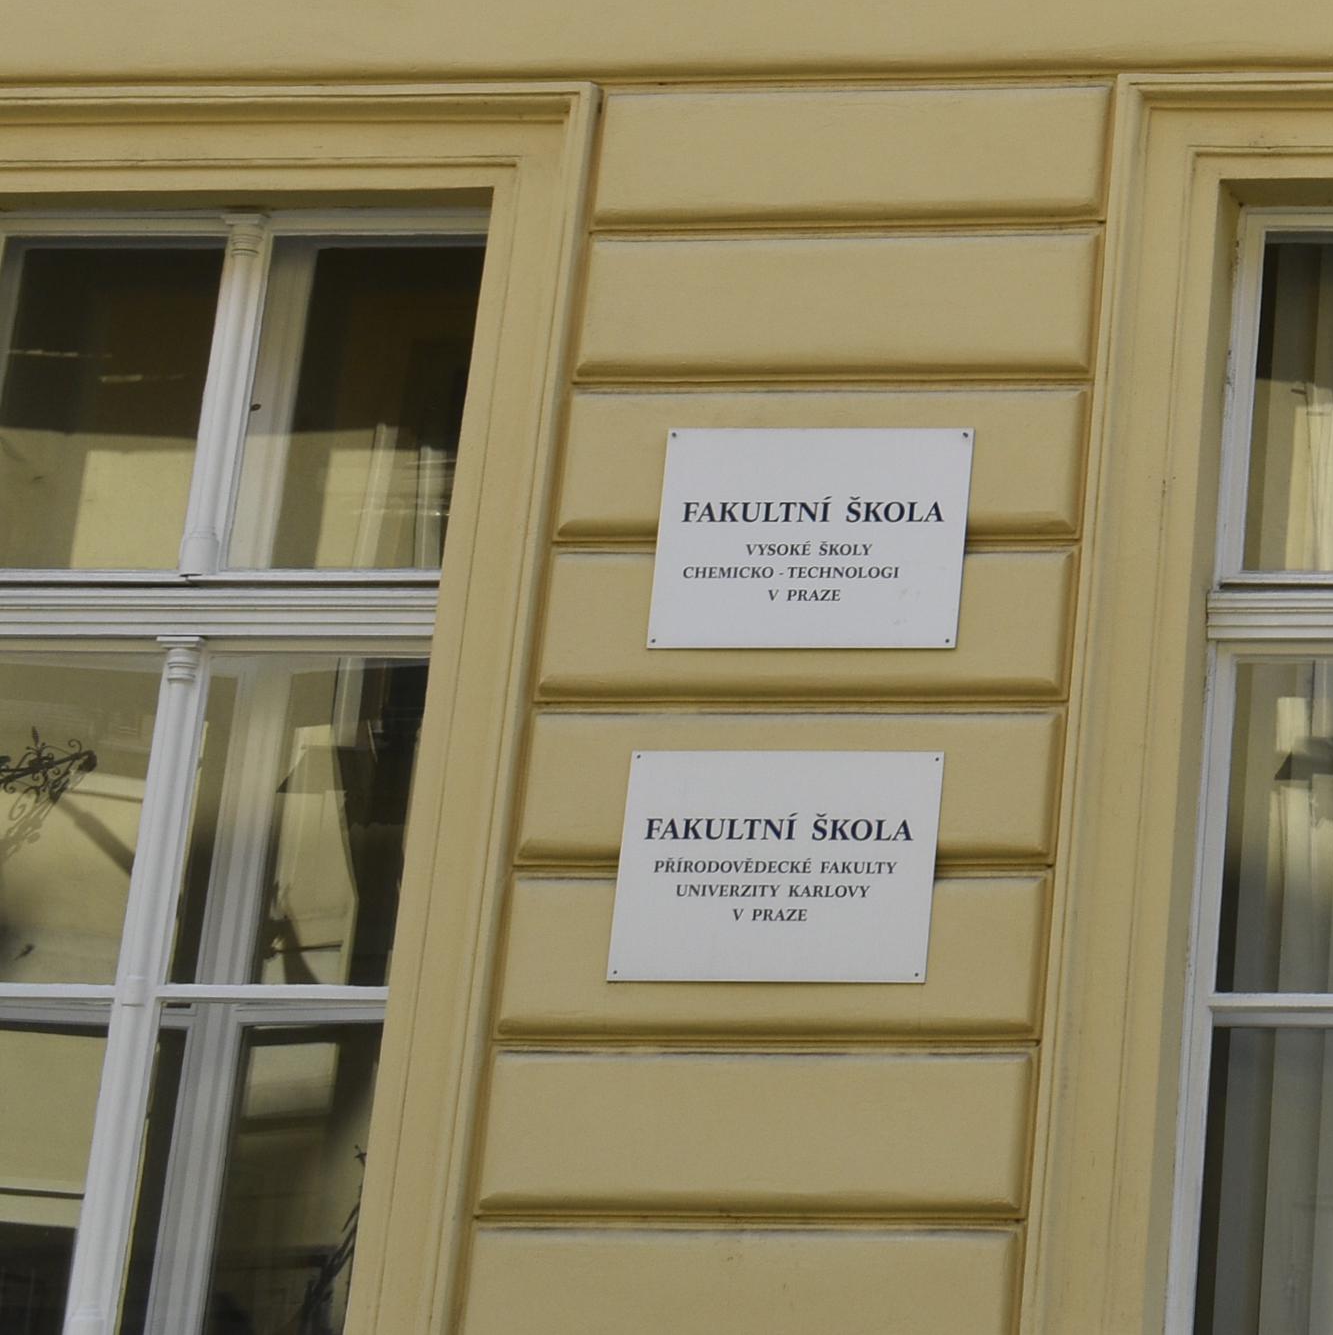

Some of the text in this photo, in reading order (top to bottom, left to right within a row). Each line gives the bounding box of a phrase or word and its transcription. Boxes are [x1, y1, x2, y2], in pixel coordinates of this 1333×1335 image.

[682, 496, 944, 523] FAKULTNÍ ŠKOLA
[746, 540, 873, 557] VYSOKÉ ŠKOLY
[682, 566, 774, 579] CHEMICKO
[787, 566, 899, 579] TECHNOLOGI
[767, 589, 841, 602] V PRAZE
[644, 812, 913, 842] FAKULTNÍ ŠKOLA
[653, 857, 897, 875] PŘÍRODOVĚDECKÉ FAKULTY
[676, 884, 870, 898] UNIVERZITY KARLOVY
[732, 908, 808, 922] V PRAZE
